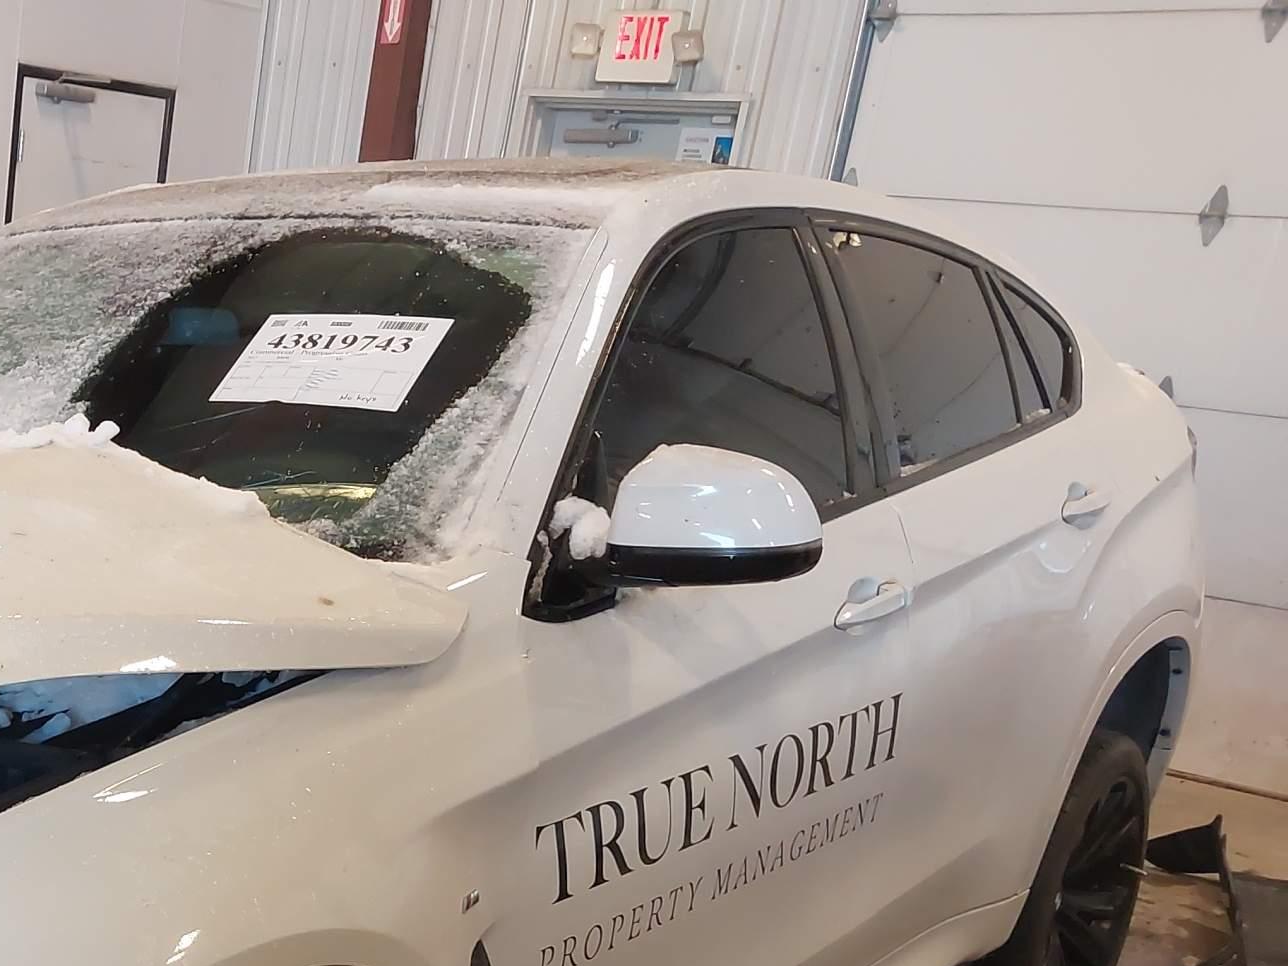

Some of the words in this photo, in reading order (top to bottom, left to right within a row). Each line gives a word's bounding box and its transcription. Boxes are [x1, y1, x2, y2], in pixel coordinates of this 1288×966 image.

[615, 16, 670, 60] EXIT
[267, 333, 414, 353] 43819743
[535, 765, 714, 904] TRUE
[726, 692, 903, 832] NORTH
[711, 792, 885, 901] MANAGEMENT
